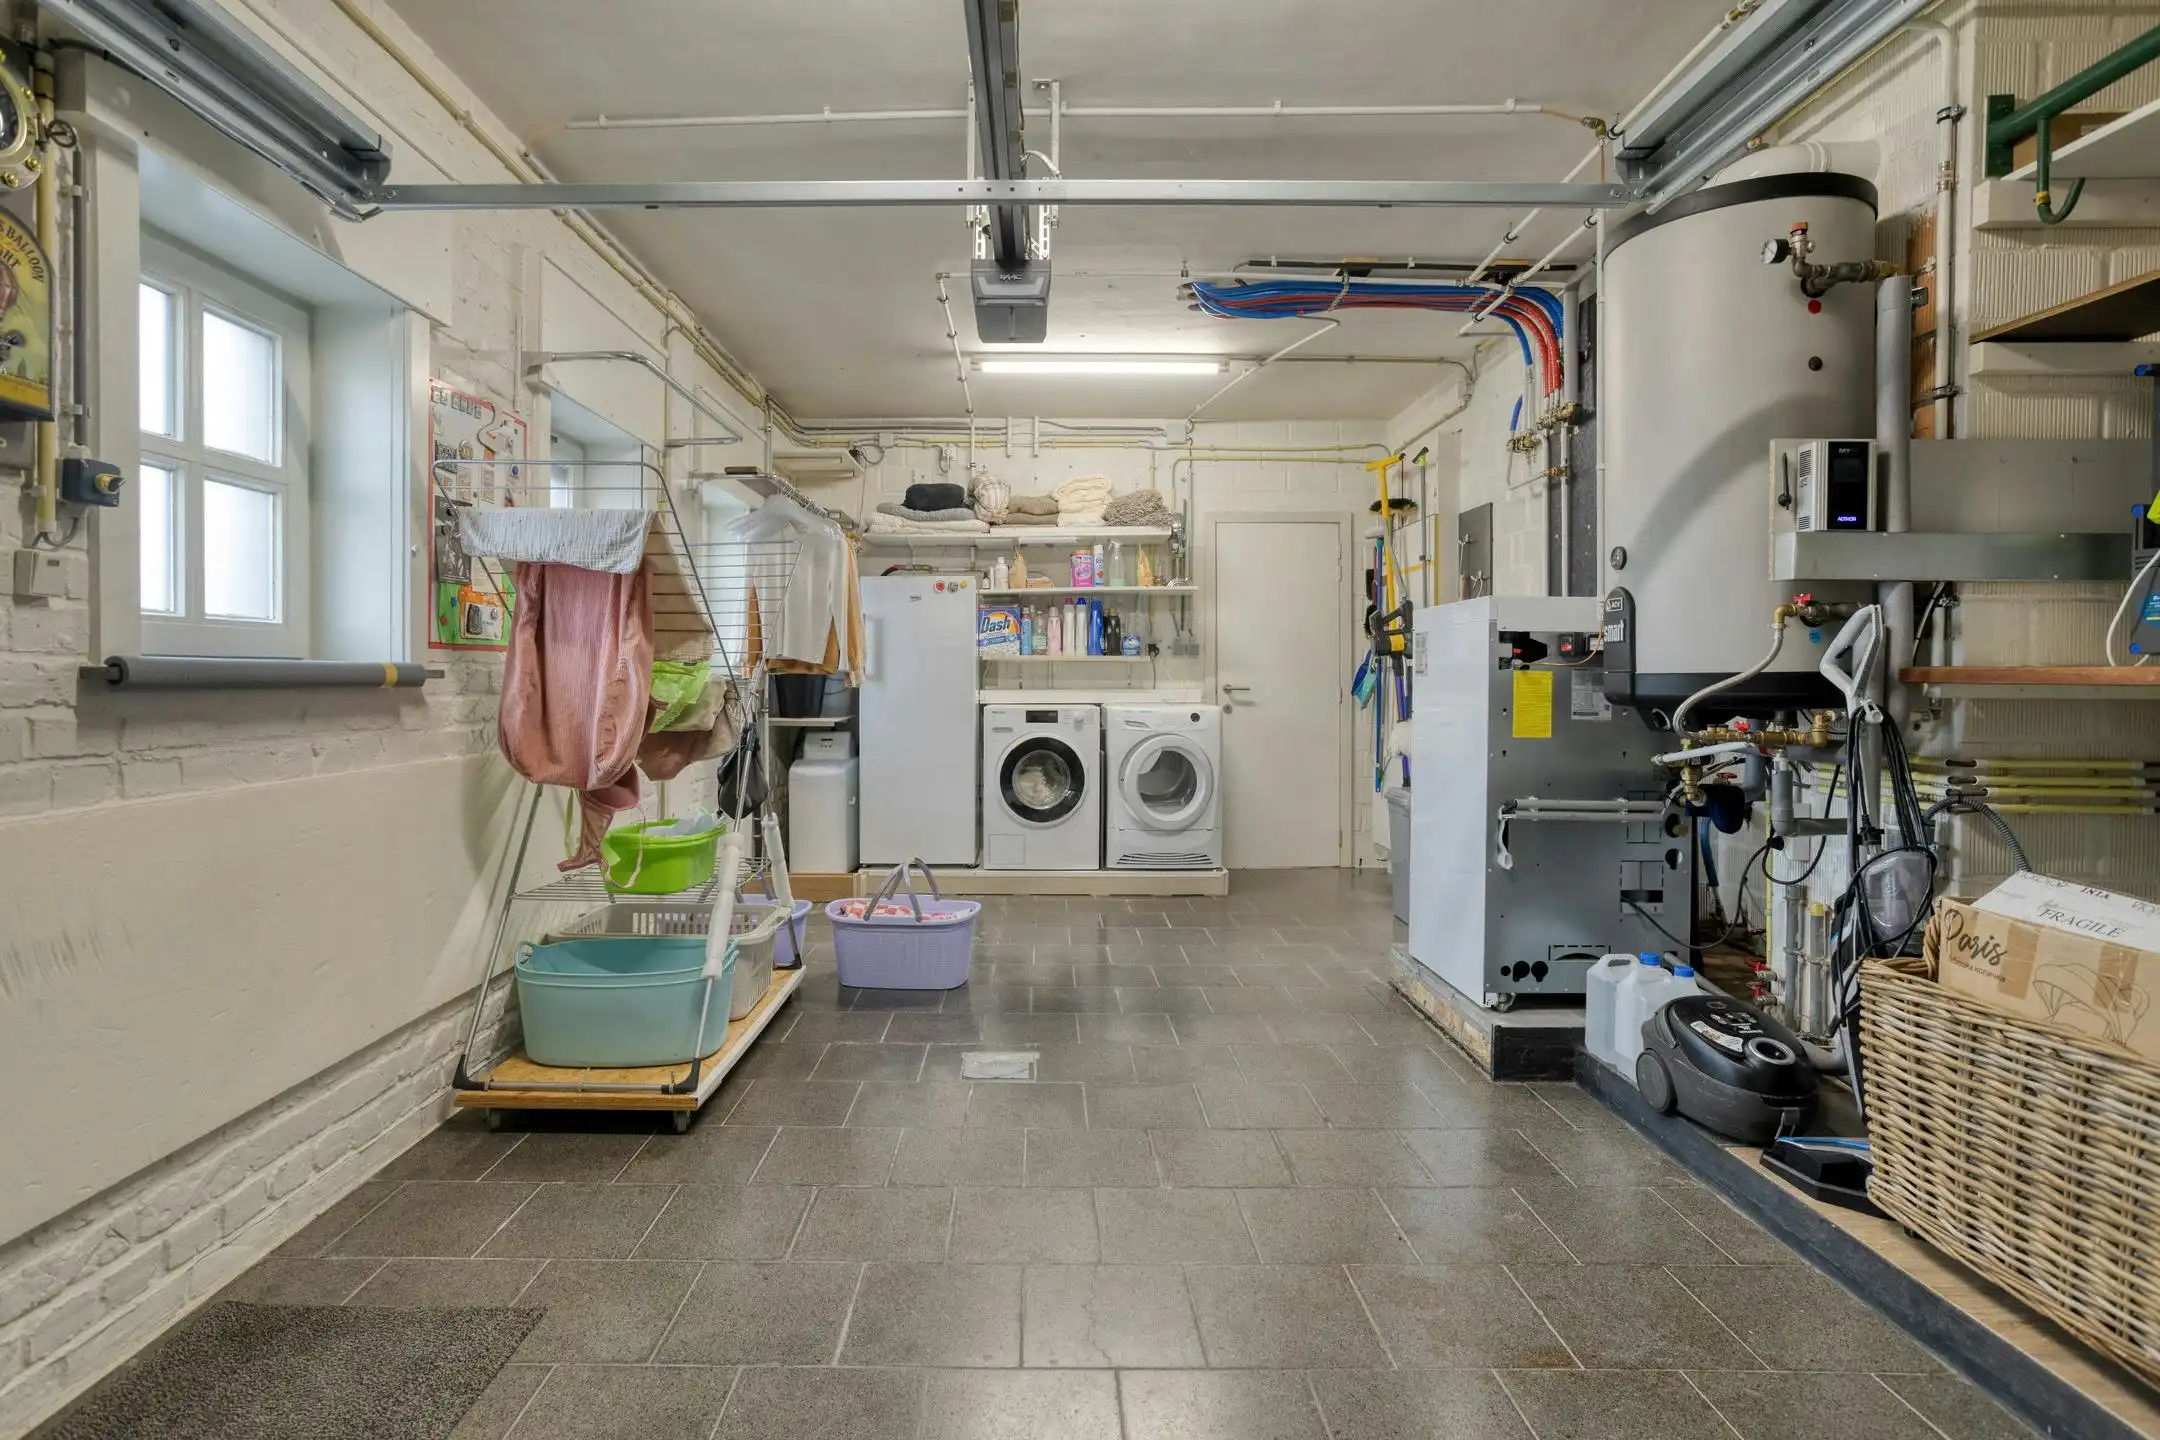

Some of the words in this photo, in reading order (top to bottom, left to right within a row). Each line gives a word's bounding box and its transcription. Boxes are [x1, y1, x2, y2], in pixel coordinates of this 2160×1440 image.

[6, 225, 44, 283] BALLOON
[981, 614, 1012, 634] Dash
[1944, 908, 2008, 966] Paris
[2038, 908, 2127, 938] FRAGILE
